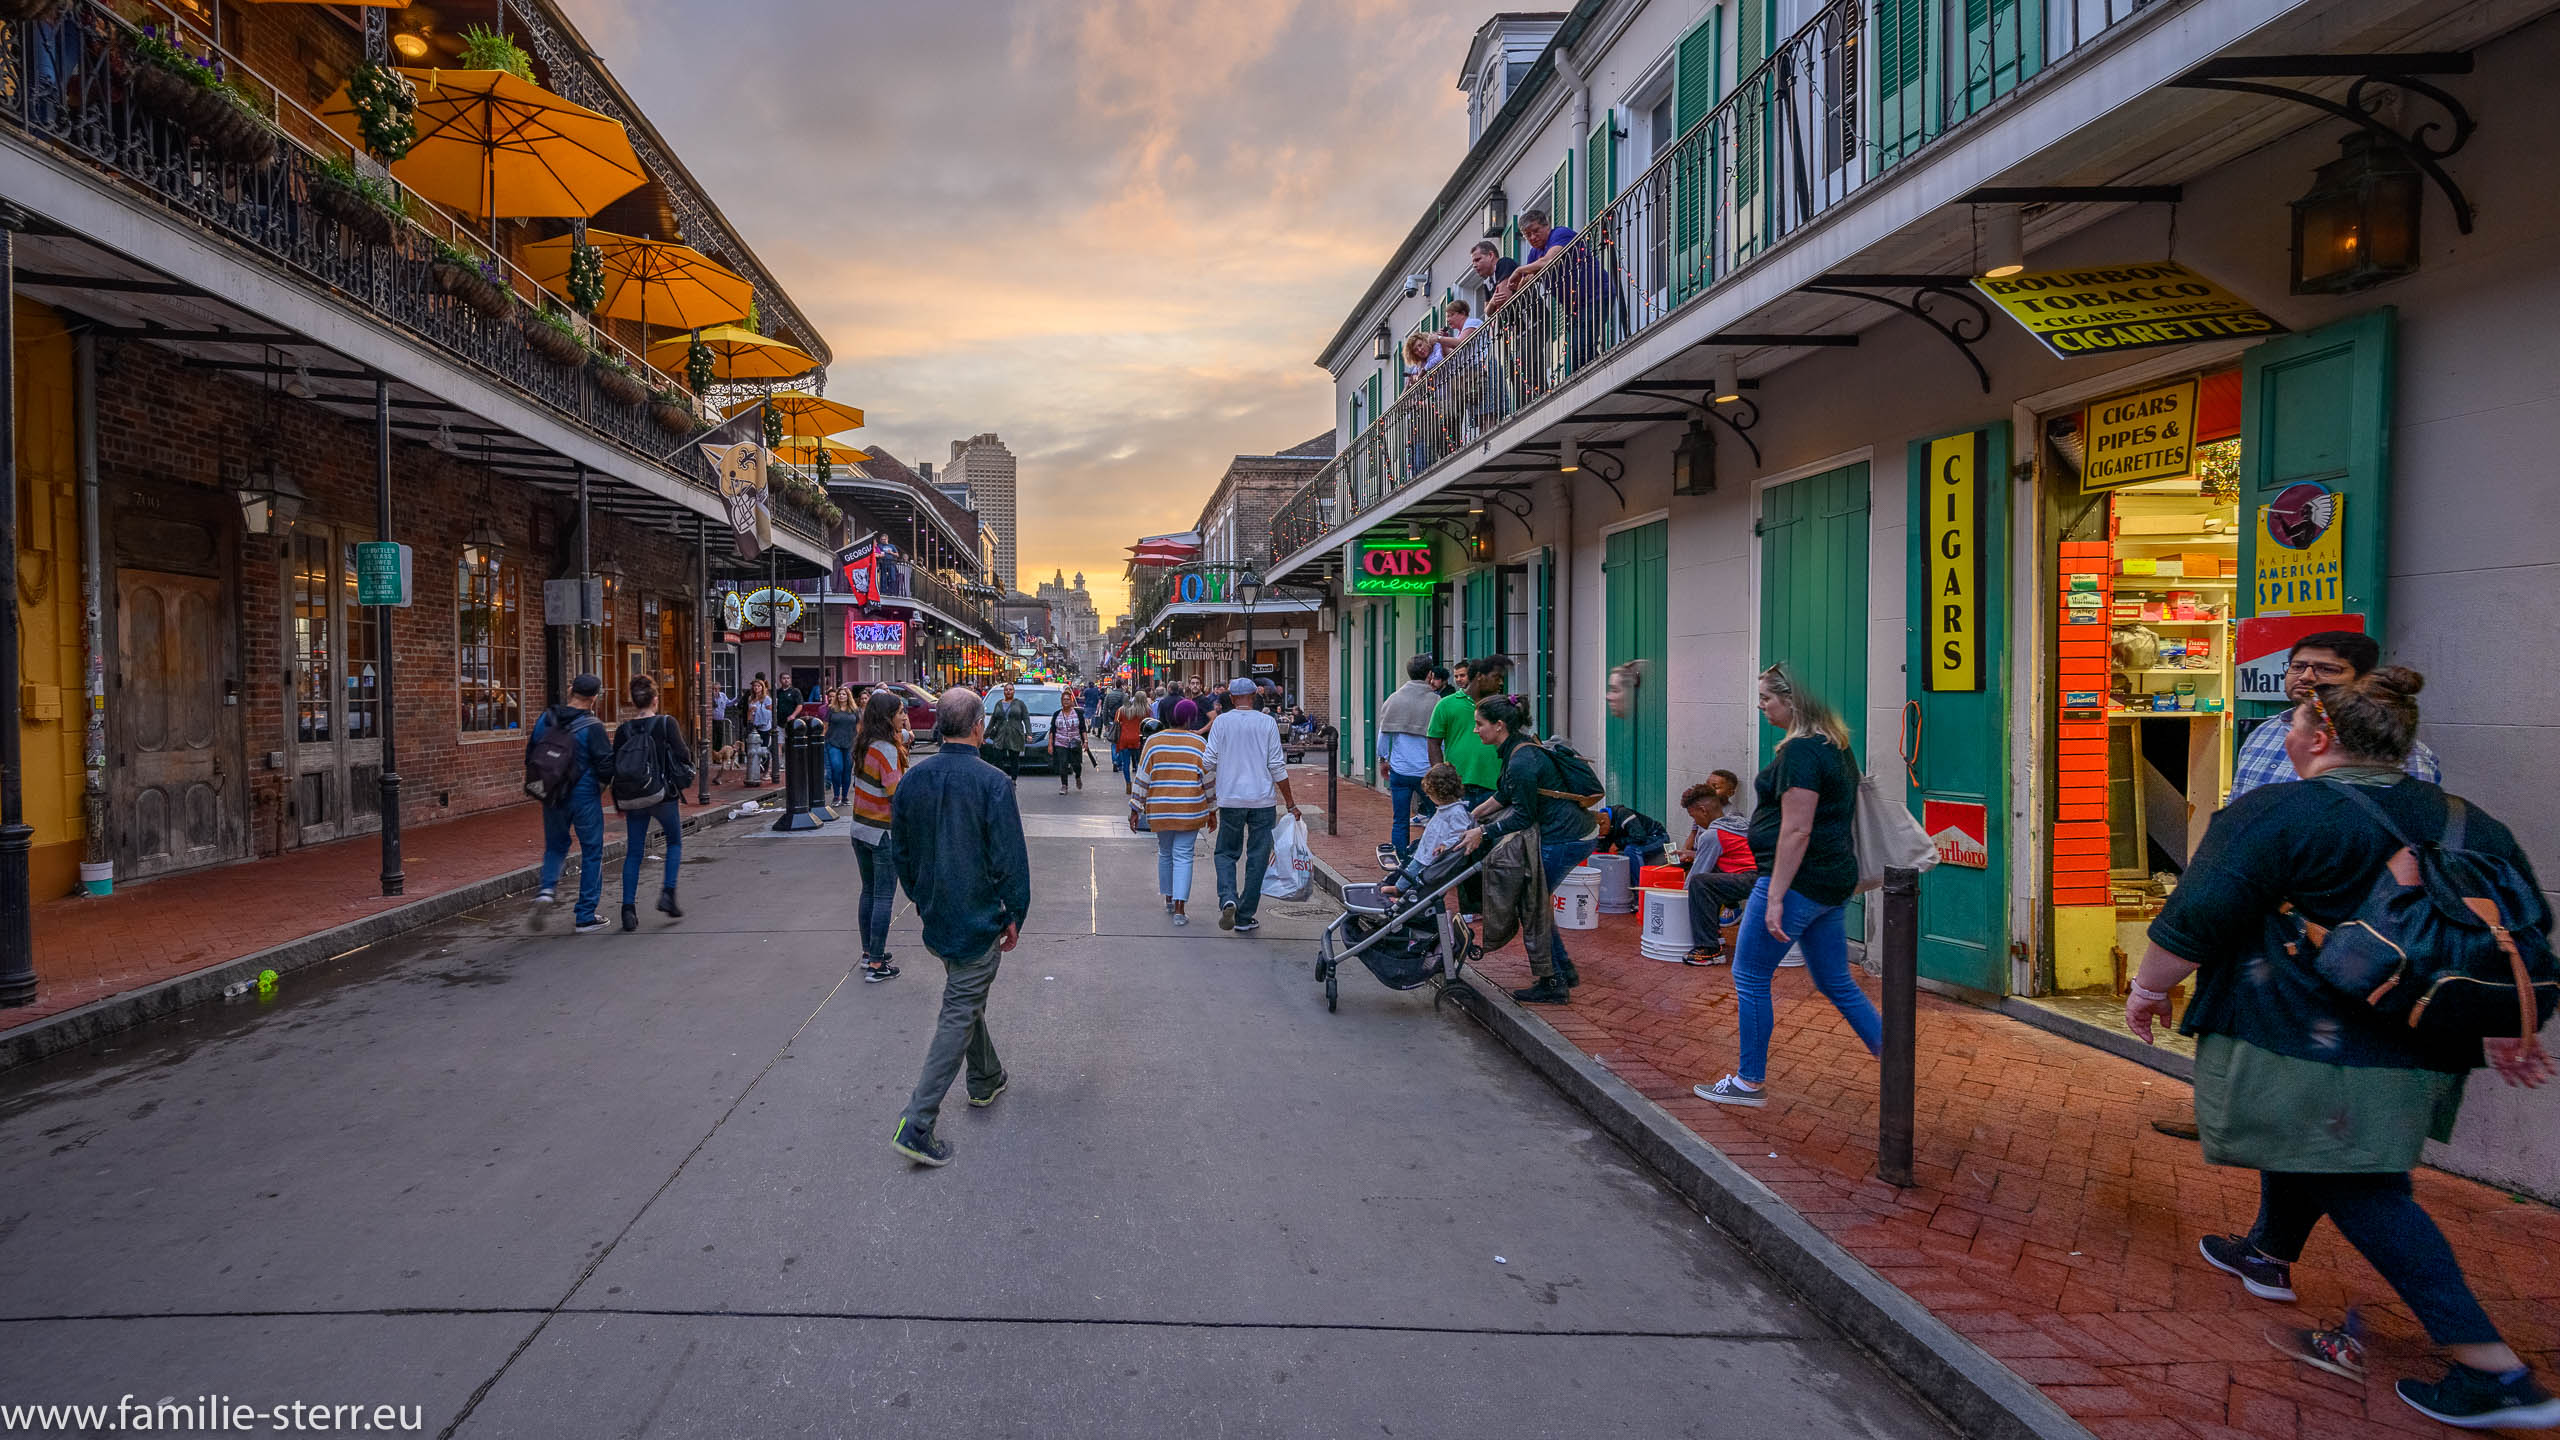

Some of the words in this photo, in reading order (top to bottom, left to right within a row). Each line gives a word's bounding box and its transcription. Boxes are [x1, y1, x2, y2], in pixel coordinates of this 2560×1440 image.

[1986, 263, 2189, 295] BOURBON
[2013, 282, 2211, 313] TOBACCO
[2044, 309, 2138, 328] CIGARS
[2051, 312, 2272, 351] CIGARETTES
[2103, 394, 2178, 425] CIGARS
[2097, 425, 2157, 452] PIPES
[2161, 420, 2180, 439] &
[2090, 446, 2184, 478] CIGARETTES
[1363, 549, 1432, 575] CATS
[1941, 454, 1963, 670] CIGARS
[2258, 560, 2337, 580] AMERICAN
[2259, 549, 2337, 566] NATURAL
[1170, 573, 1228, 603] JOY
[1357, 579, 1437, 590] meow
[2258, 576, 2337, 605] SPIRIT
[856, 641, 875, 651] Krazy
[876, 641, 901, 651] Korner
[1938, 840, 1986, 866] arlboro
